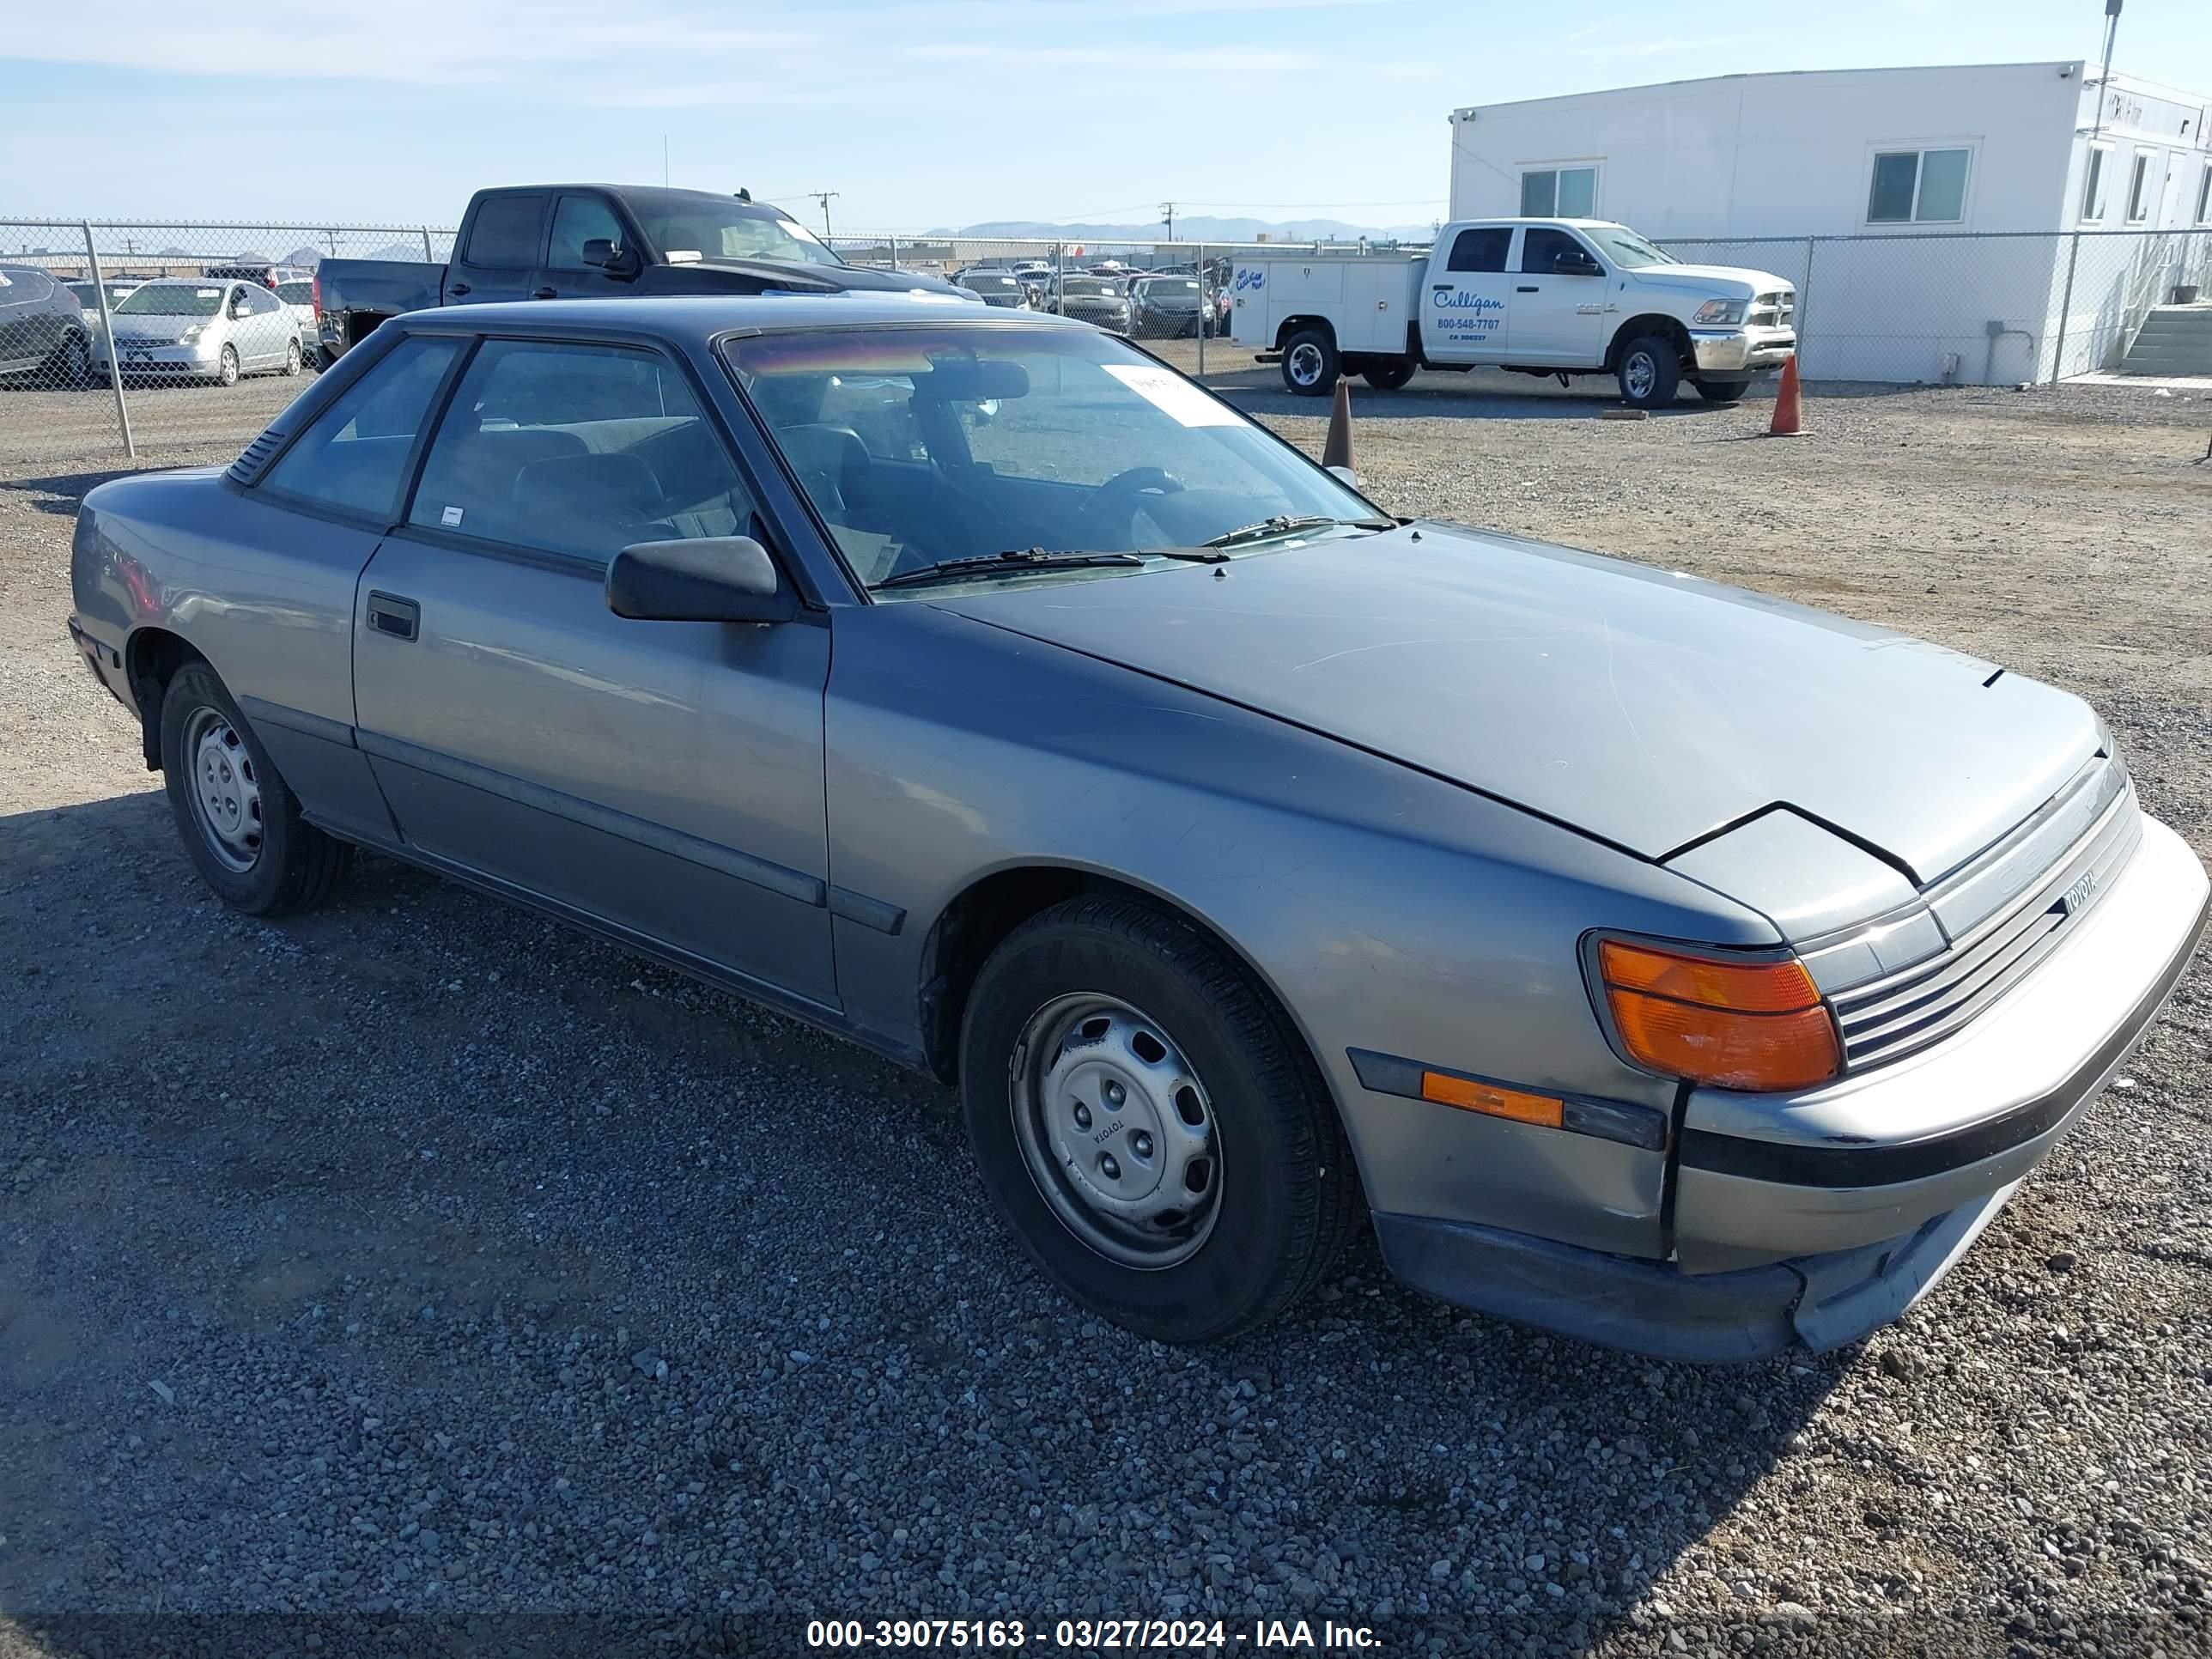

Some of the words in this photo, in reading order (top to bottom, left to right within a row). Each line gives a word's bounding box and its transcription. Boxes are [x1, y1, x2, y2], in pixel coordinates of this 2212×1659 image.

[1434, 291, 1505, 316] Culligan
[1437, 319, 1500, 330] 800-548-7707
[2063, 871, 2097, 913] TOYOTA
[1093, 1119, 1125, 1145] TOYOTA
